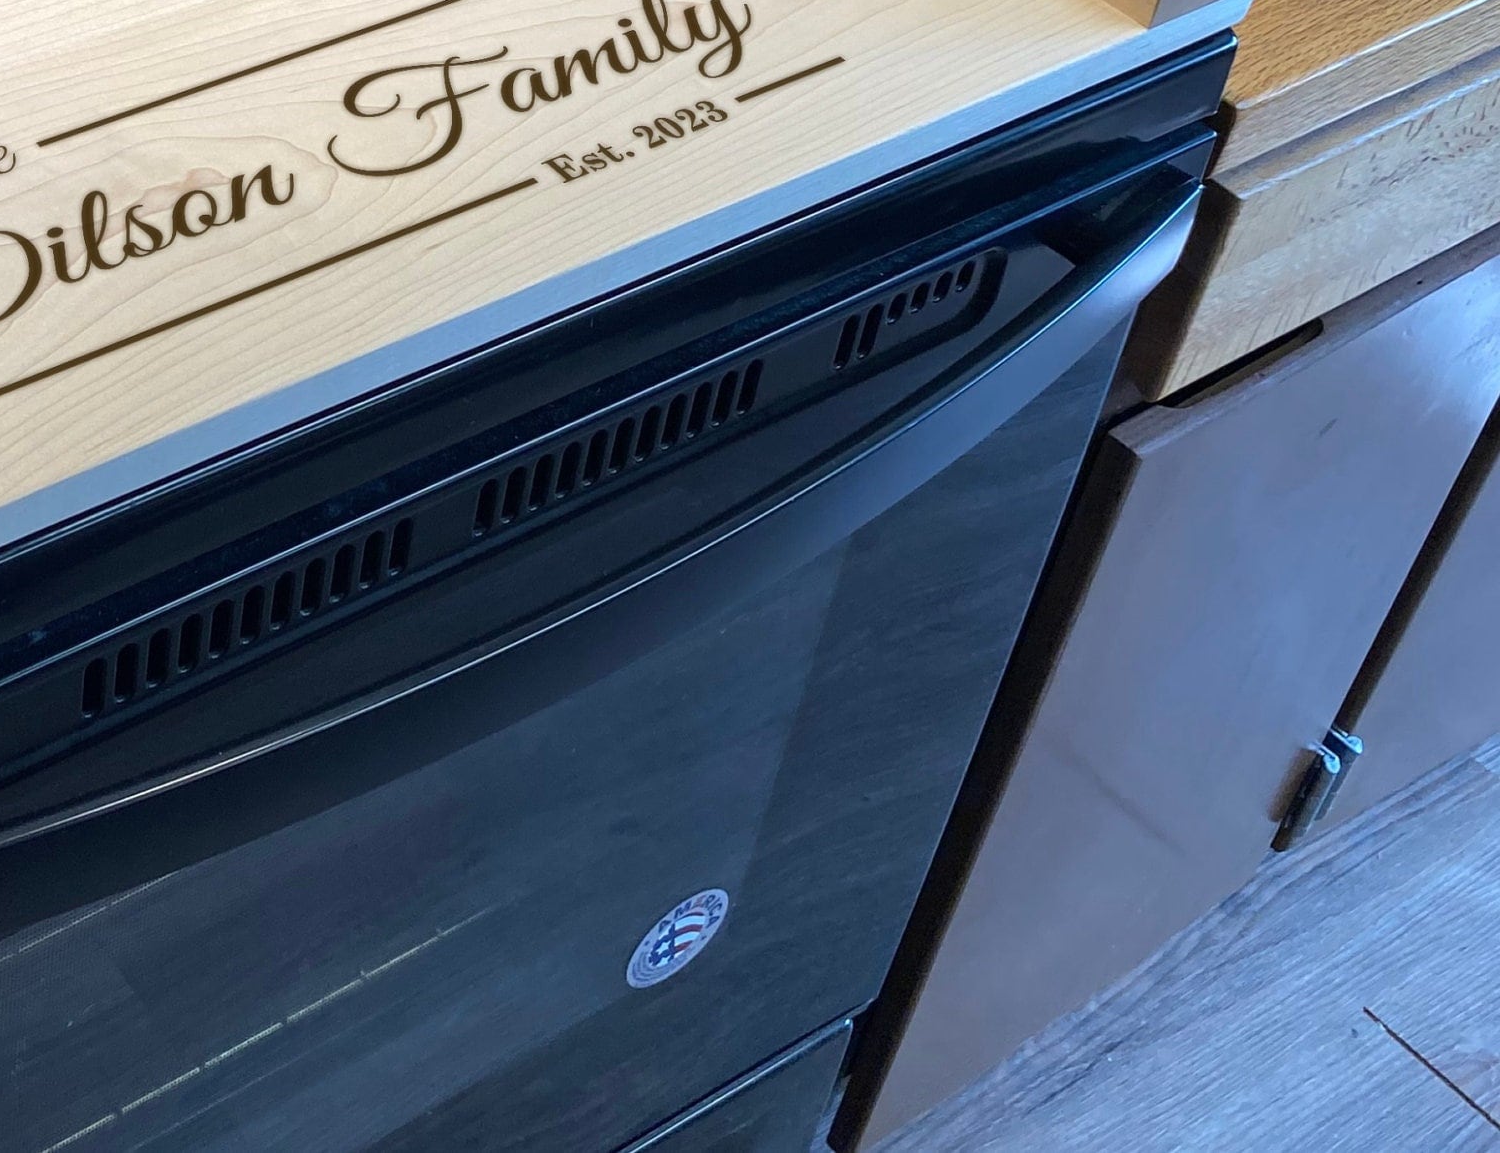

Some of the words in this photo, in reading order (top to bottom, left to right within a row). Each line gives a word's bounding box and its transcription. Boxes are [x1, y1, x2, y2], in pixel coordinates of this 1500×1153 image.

[543, 138, 636, 185] Est.
[634, 99, 729, 148] 2023
[658, 894, 722, 934] AMERICA
